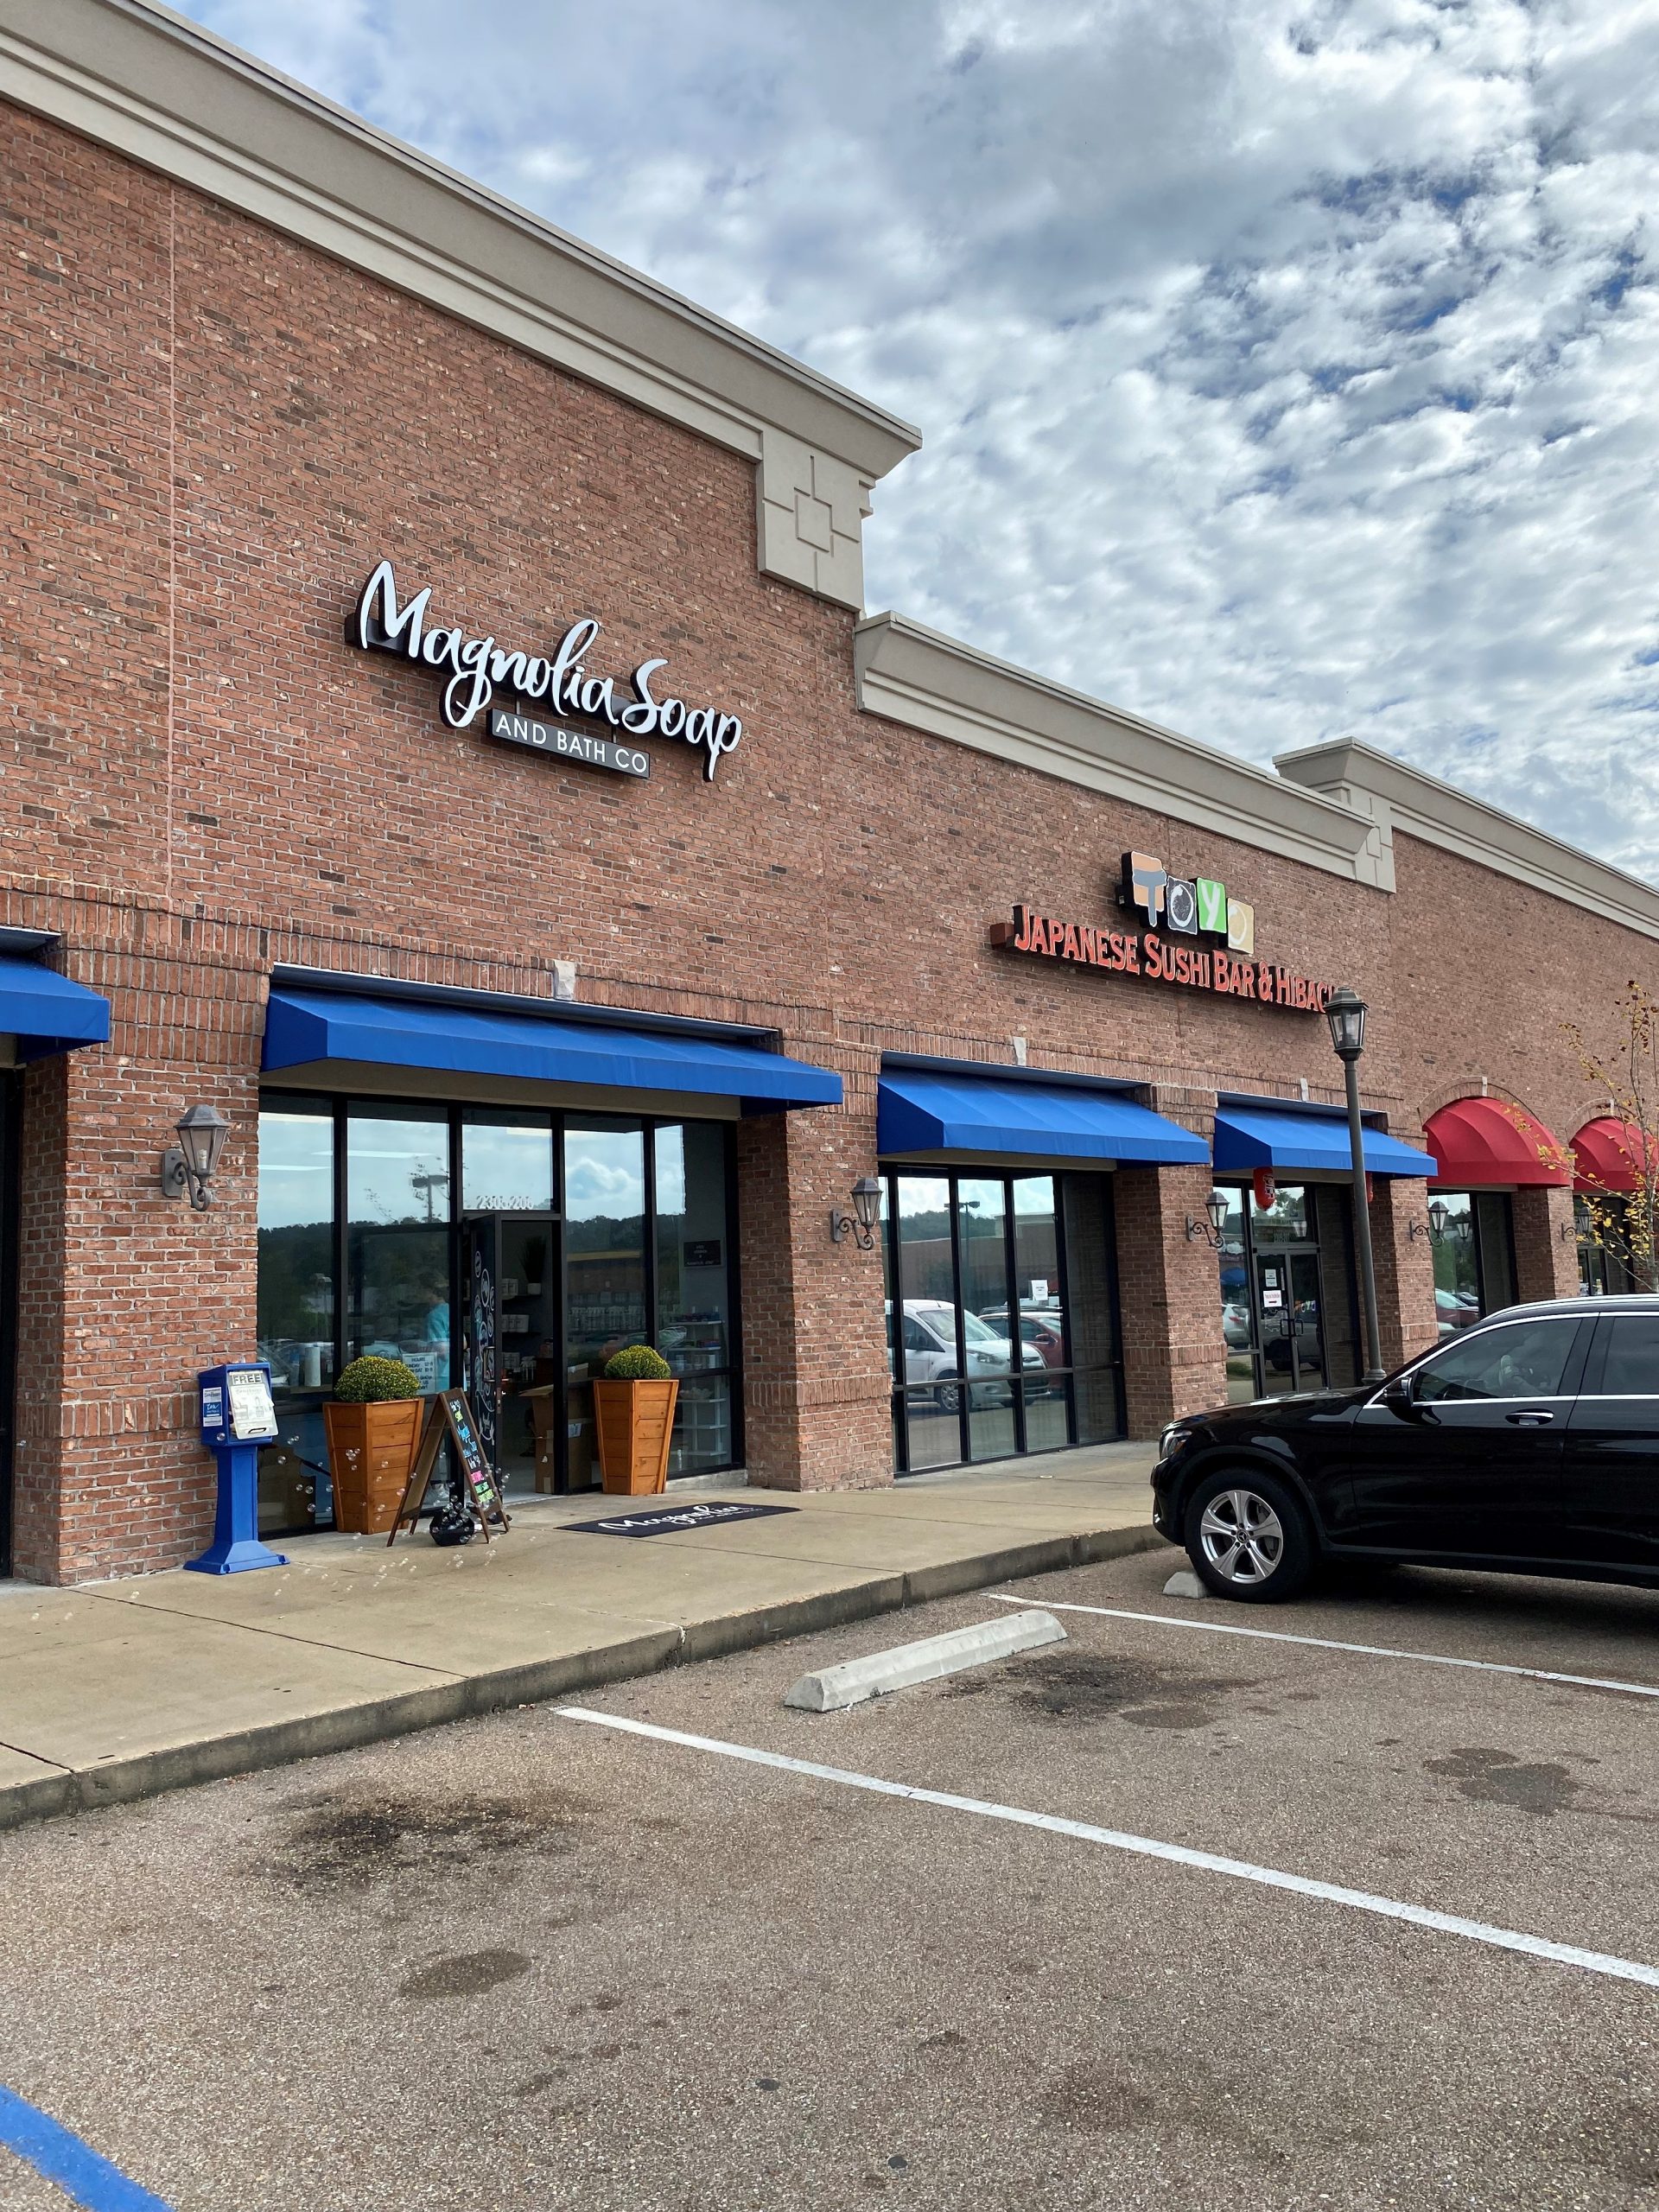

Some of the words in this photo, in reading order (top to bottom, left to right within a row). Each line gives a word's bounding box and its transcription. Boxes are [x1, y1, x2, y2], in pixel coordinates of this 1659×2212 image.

[358, 560, 620, 728] Magnolia
[621, 658, 743, 781] Soap
[495, 714, 547, 744] AND
[557, 732, 607, 762] BATH
[614, 748, 648, 773] CO
[1014, 905, 1141, 974] JAPANESE
[1144, 933, 1211, 988] SUSHI
[1213, 950, 1256, 999] BAR
[1258, 961, 1274, 1002] &
[1276, 967, 1333, 1014] HIBAC
[233, 1374, 261, 1383] FREE
